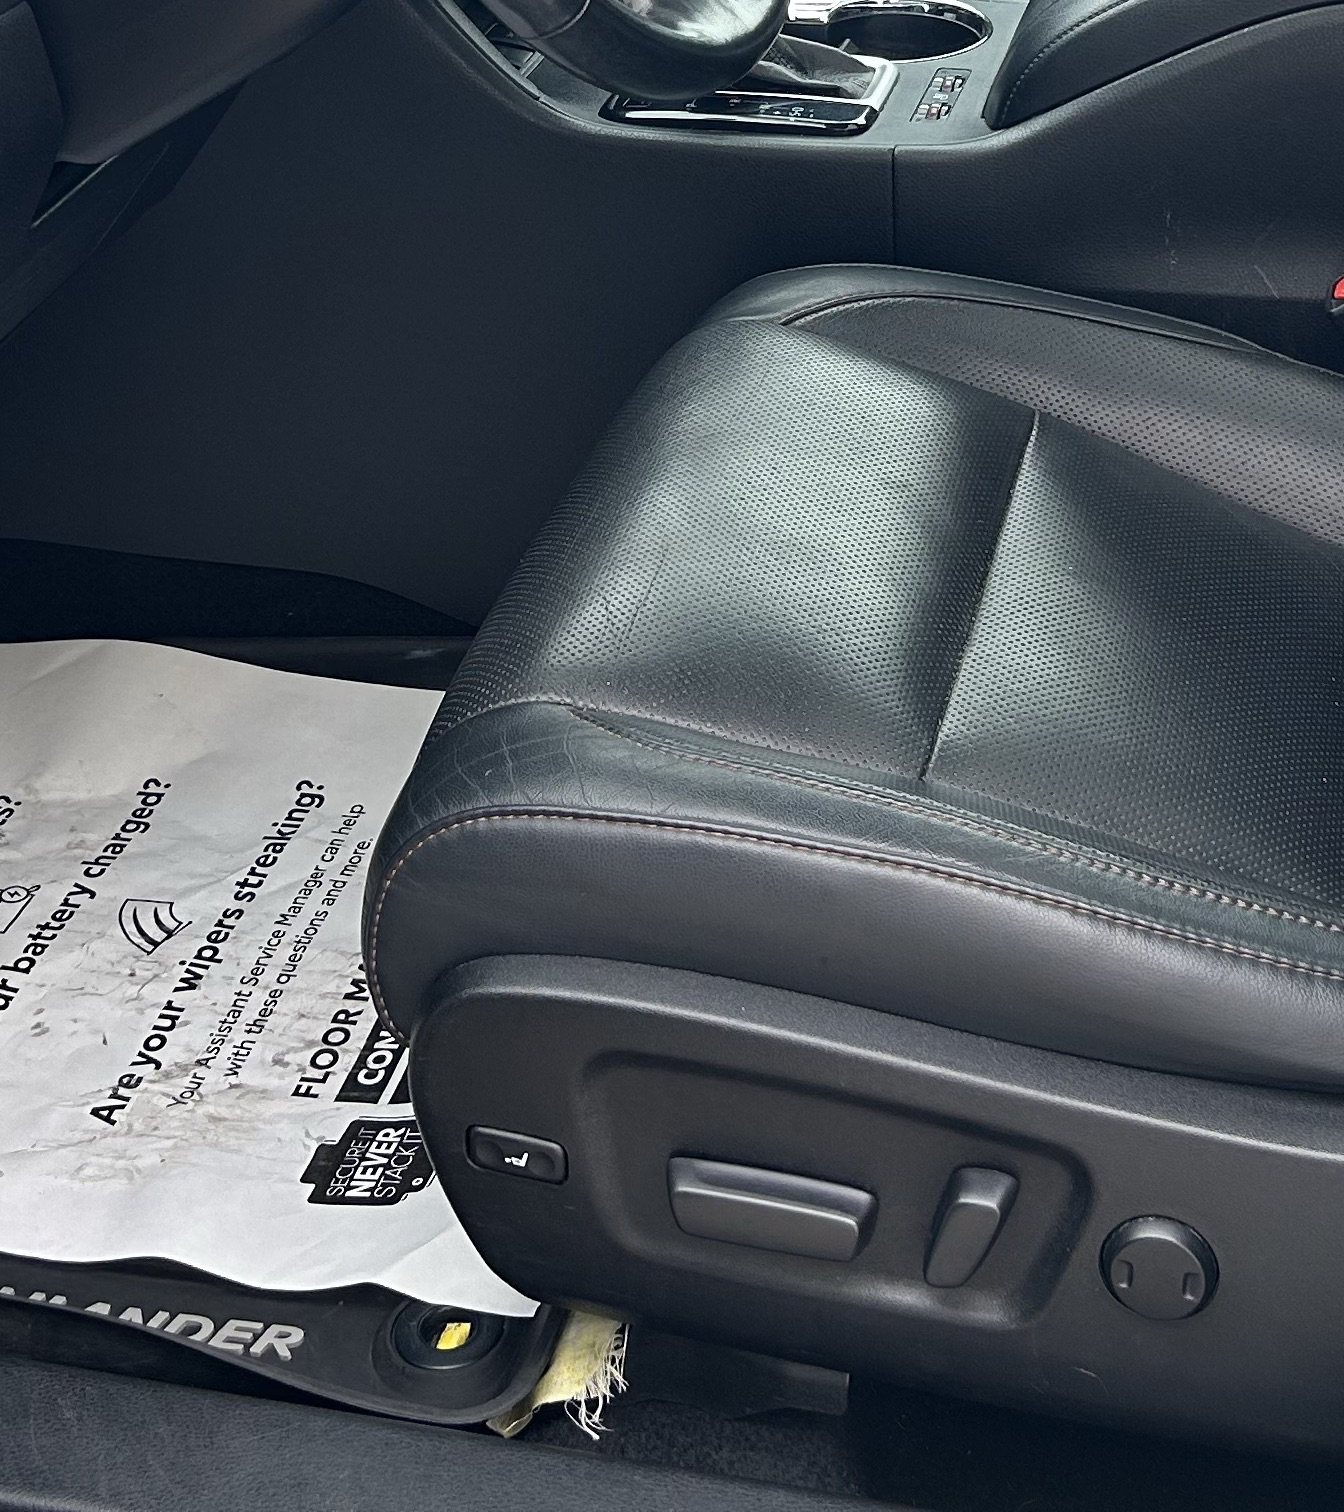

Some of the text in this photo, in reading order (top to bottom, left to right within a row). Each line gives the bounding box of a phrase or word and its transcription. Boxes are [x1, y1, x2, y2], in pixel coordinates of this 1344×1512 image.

[0, 882, 97, 974] battery
[81, 778, 171, 878] charged?
[90, 780, 325, 1126] Are your wipers streaking?
[166, 803, 366, 1108] Your Assistant Service Manager can help
[223, 838, 374, 1077] with these questions and more.
[291, 1008, 364, 1099] FLOOR
[326, 1127, 376, 1196] SECURE IT
[345, 1127, 406, 1197] NEVER
[374, 1128, 422, 1198] STACK IT
